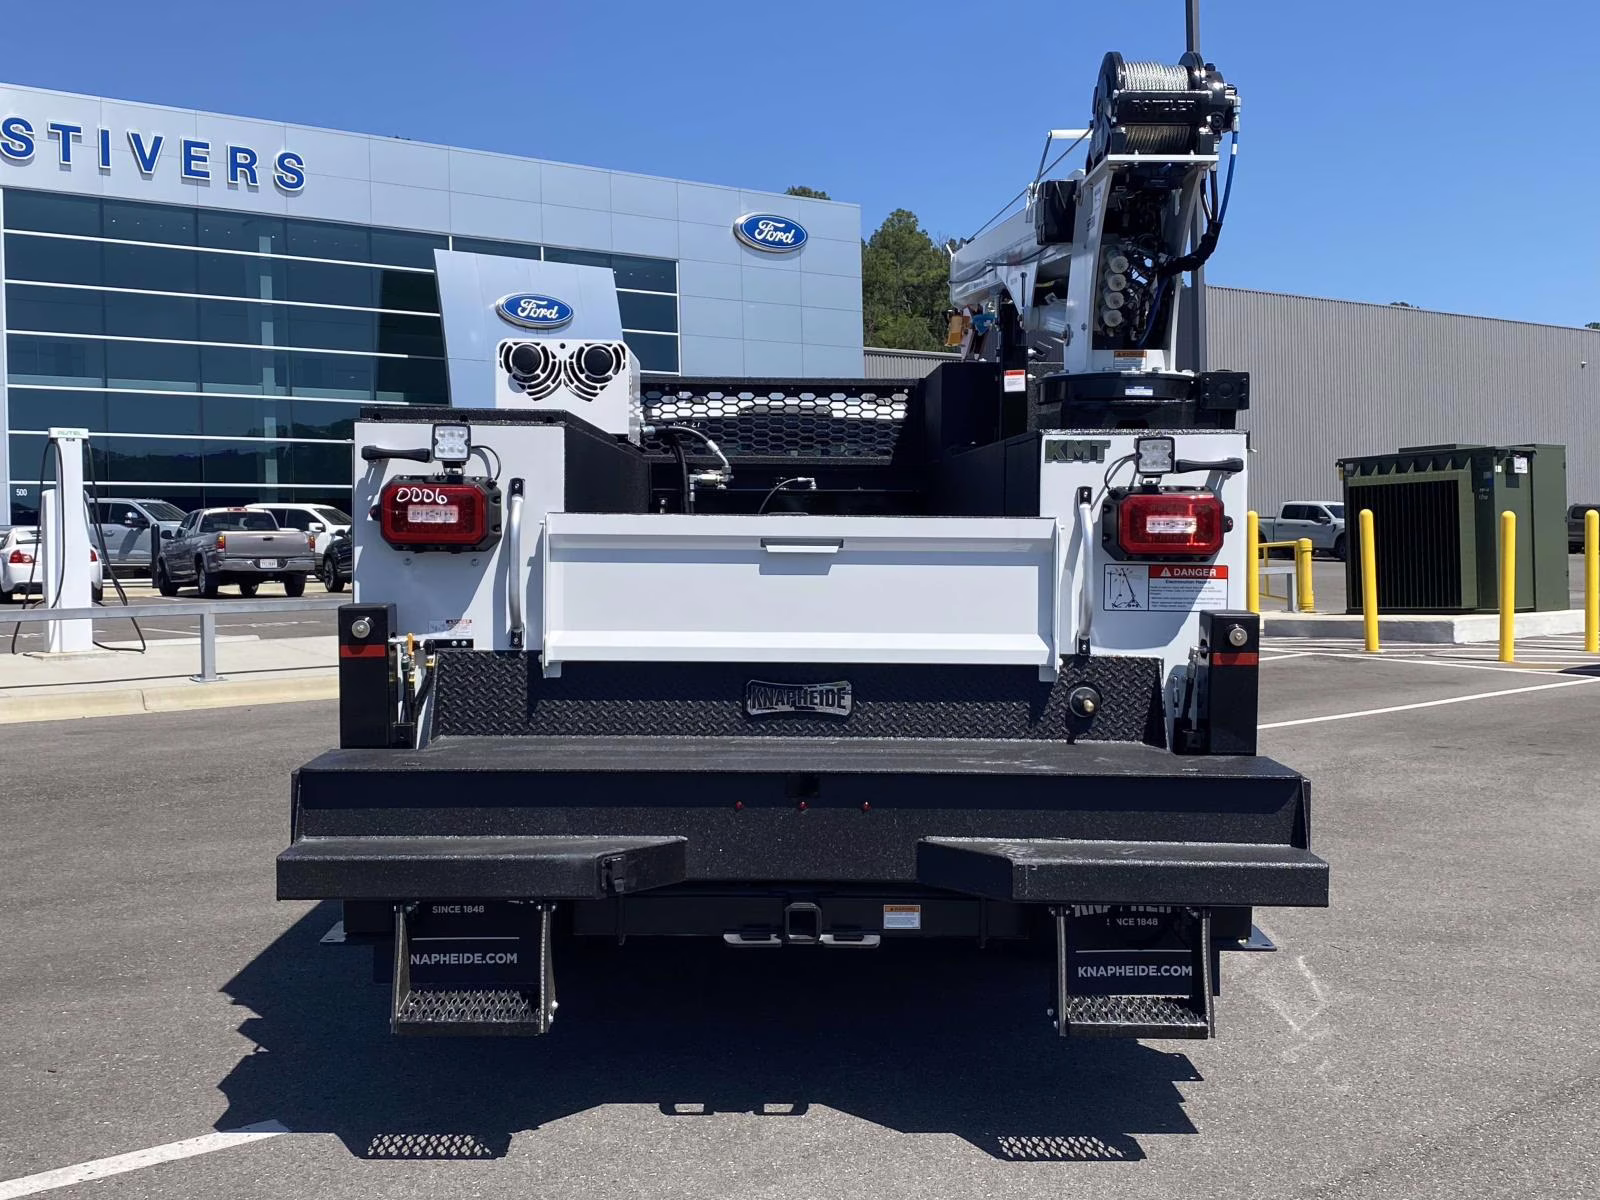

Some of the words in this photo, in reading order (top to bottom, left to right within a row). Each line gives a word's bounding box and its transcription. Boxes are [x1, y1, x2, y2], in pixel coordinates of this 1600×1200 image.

[0, 116, 305, 191] STIVERS
[754, 219, 796, 244] Ford
[517, 298, 559, 319] Ford
[1045, 440, 1111, 463] KMT
[16, 488, 28, 497] 500
[1173, 568, 1217, 577] DANGER
[749, 684, 848, 711] KNAPHEIDE
[432, 905, 461, 914] SINCE
[463, 905, 485, 913] 1848
[1137, 918, 1159, 926] 1848
[410, 952, 518, 965] NAPHEIDE.COM
[1077, 965, 1193, 978] KNAPHEIDE.COM
